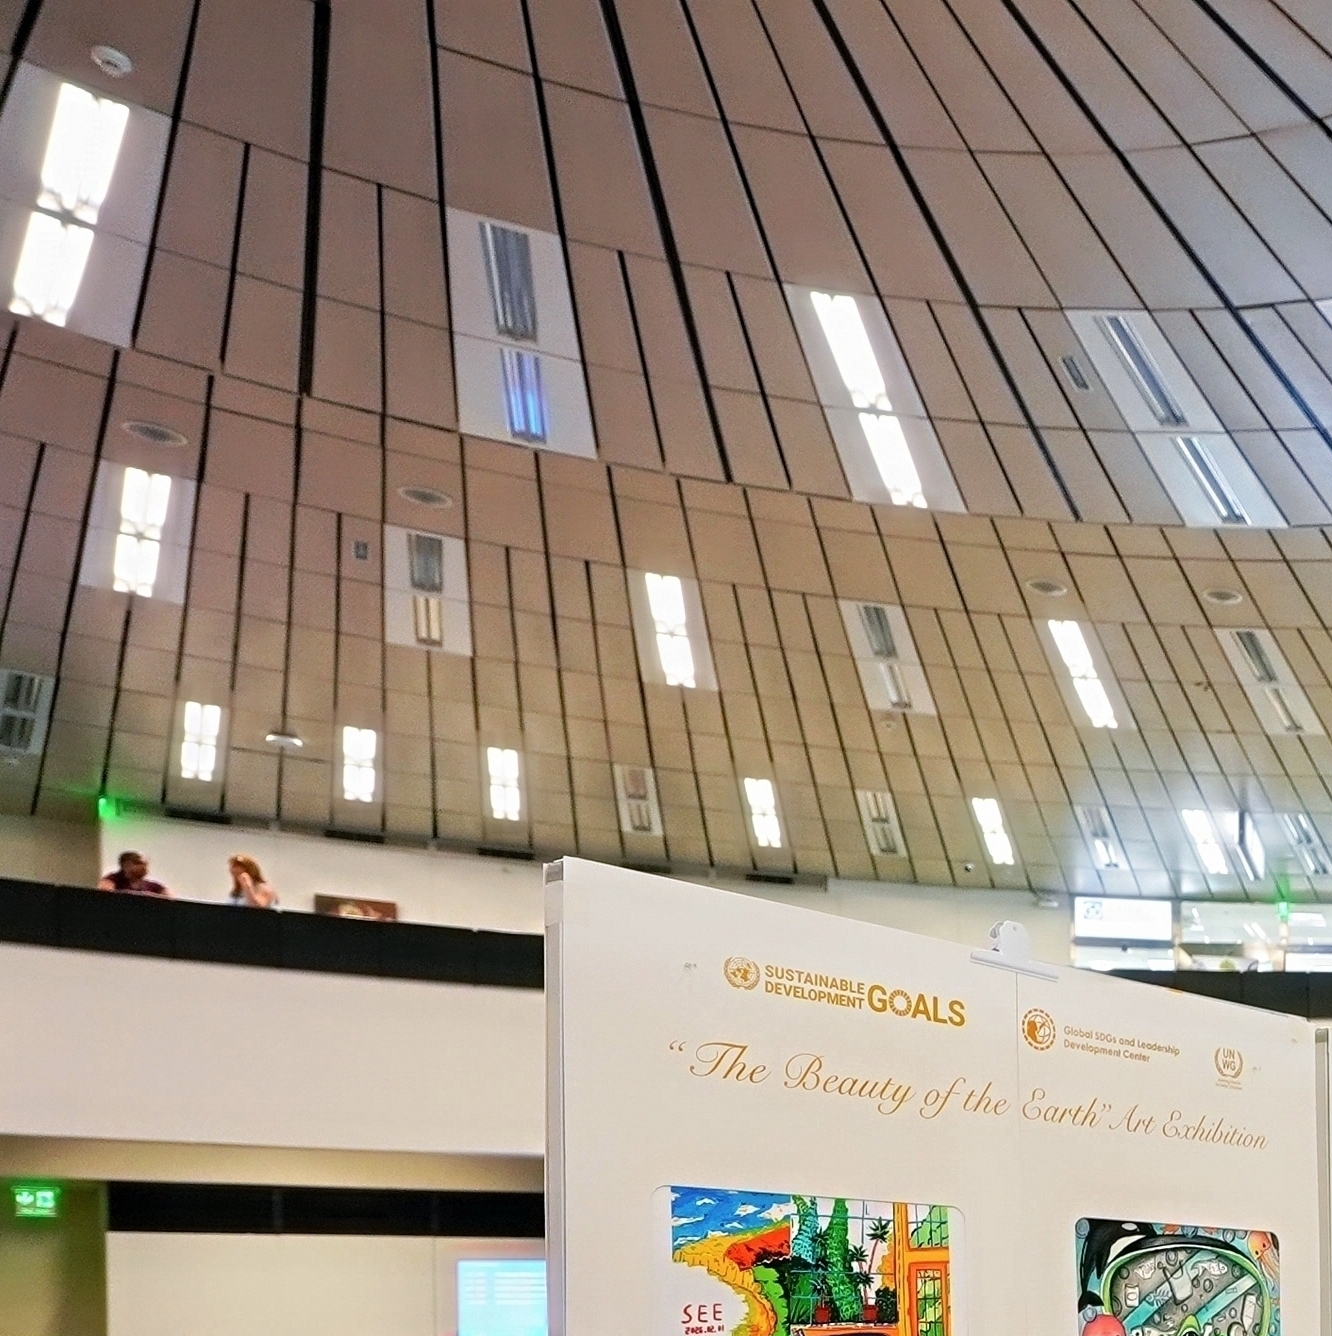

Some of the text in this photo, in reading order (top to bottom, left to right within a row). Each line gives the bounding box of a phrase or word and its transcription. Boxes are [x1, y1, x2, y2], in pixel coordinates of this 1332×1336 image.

[765, 964, 866, 995] SUSTAINABLE
[765, 981, 865, 1010] DEVELOPMENT
[867, 984, 966, 1027] GOALS
[1064, 1025, 1181, 1057] Global SDGs and Leadership
[1064, 1039, 1151, 1063] Development Center
[1222, 1047, 1236, 1060] UN
[1221, 1059, 1237, 1071] WG
[784, 1053, 917, 1116] Beauty
[919, 1077, 968, 1119] of
[962, 1081, 1011, 1116] the
[1109, 1103, 1158, 1135] Art
[1162, 1110, 1269, 1150] Exhibition
[681, 1303, 723, 1324] SEE
